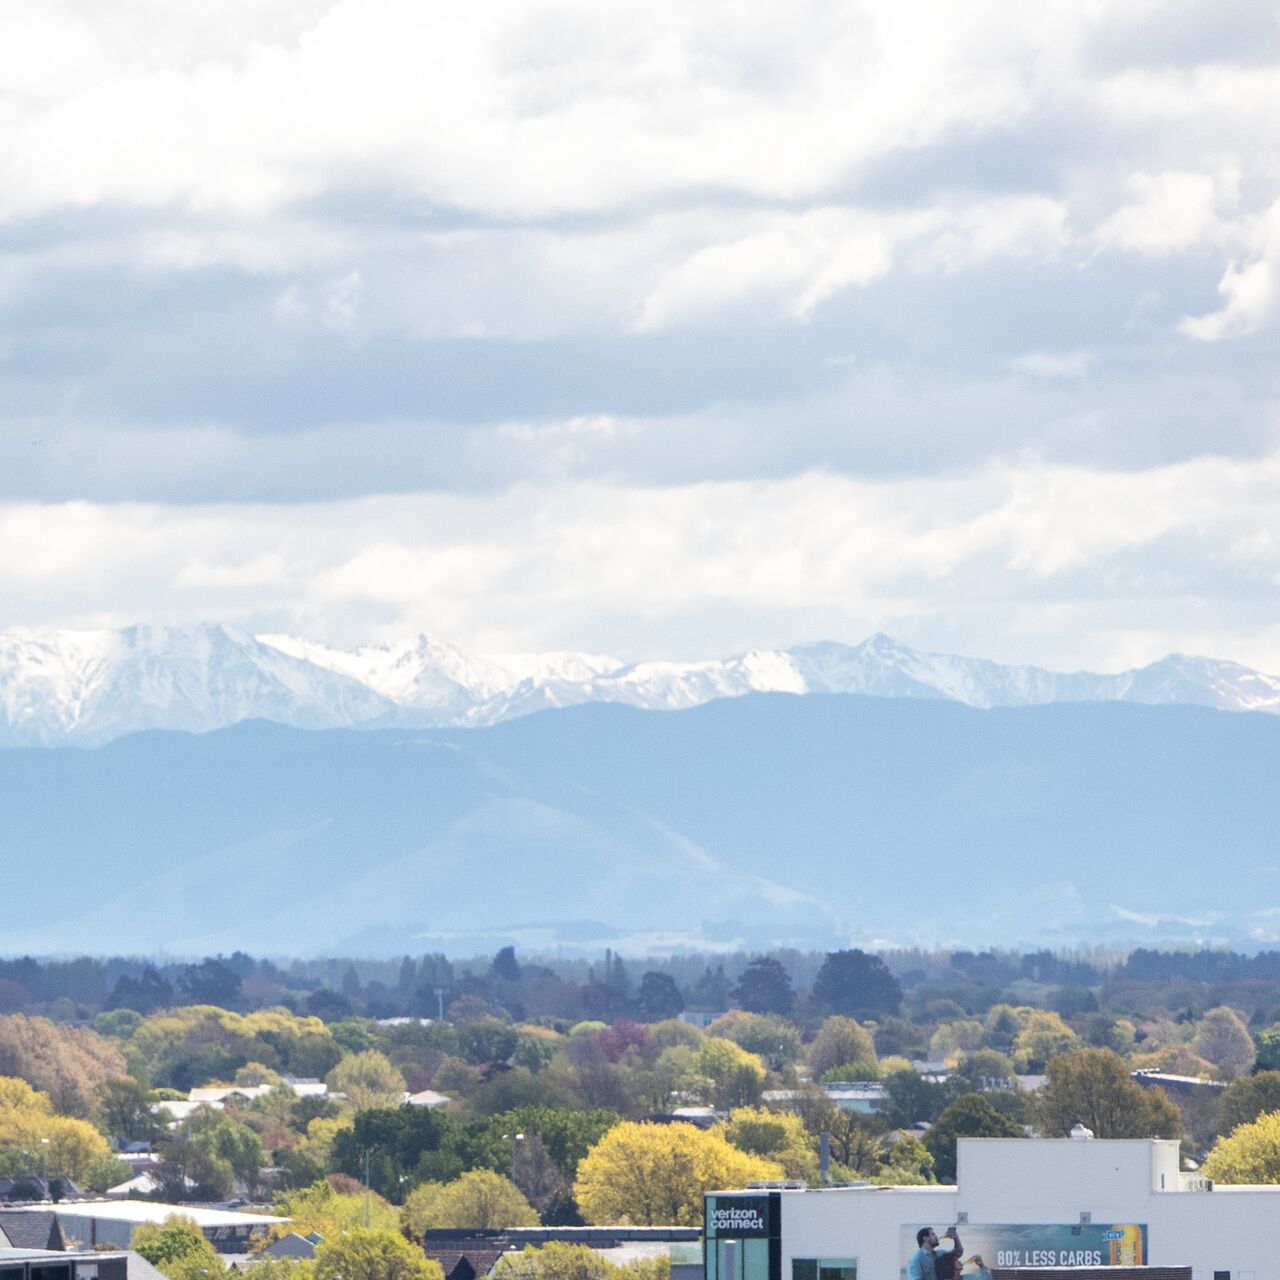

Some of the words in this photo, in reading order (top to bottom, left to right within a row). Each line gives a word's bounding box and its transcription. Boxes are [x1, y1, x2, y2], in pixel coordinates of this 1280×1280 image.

[712, 1208, 757, 1218] verizon
[711, 1218, 763, 1228] connect
[997, 1250, 1020, 1266] 80%
[1025, 1250, 1056, 1266] LESS
[1060, 1250, 1101, 1266] CARBS
